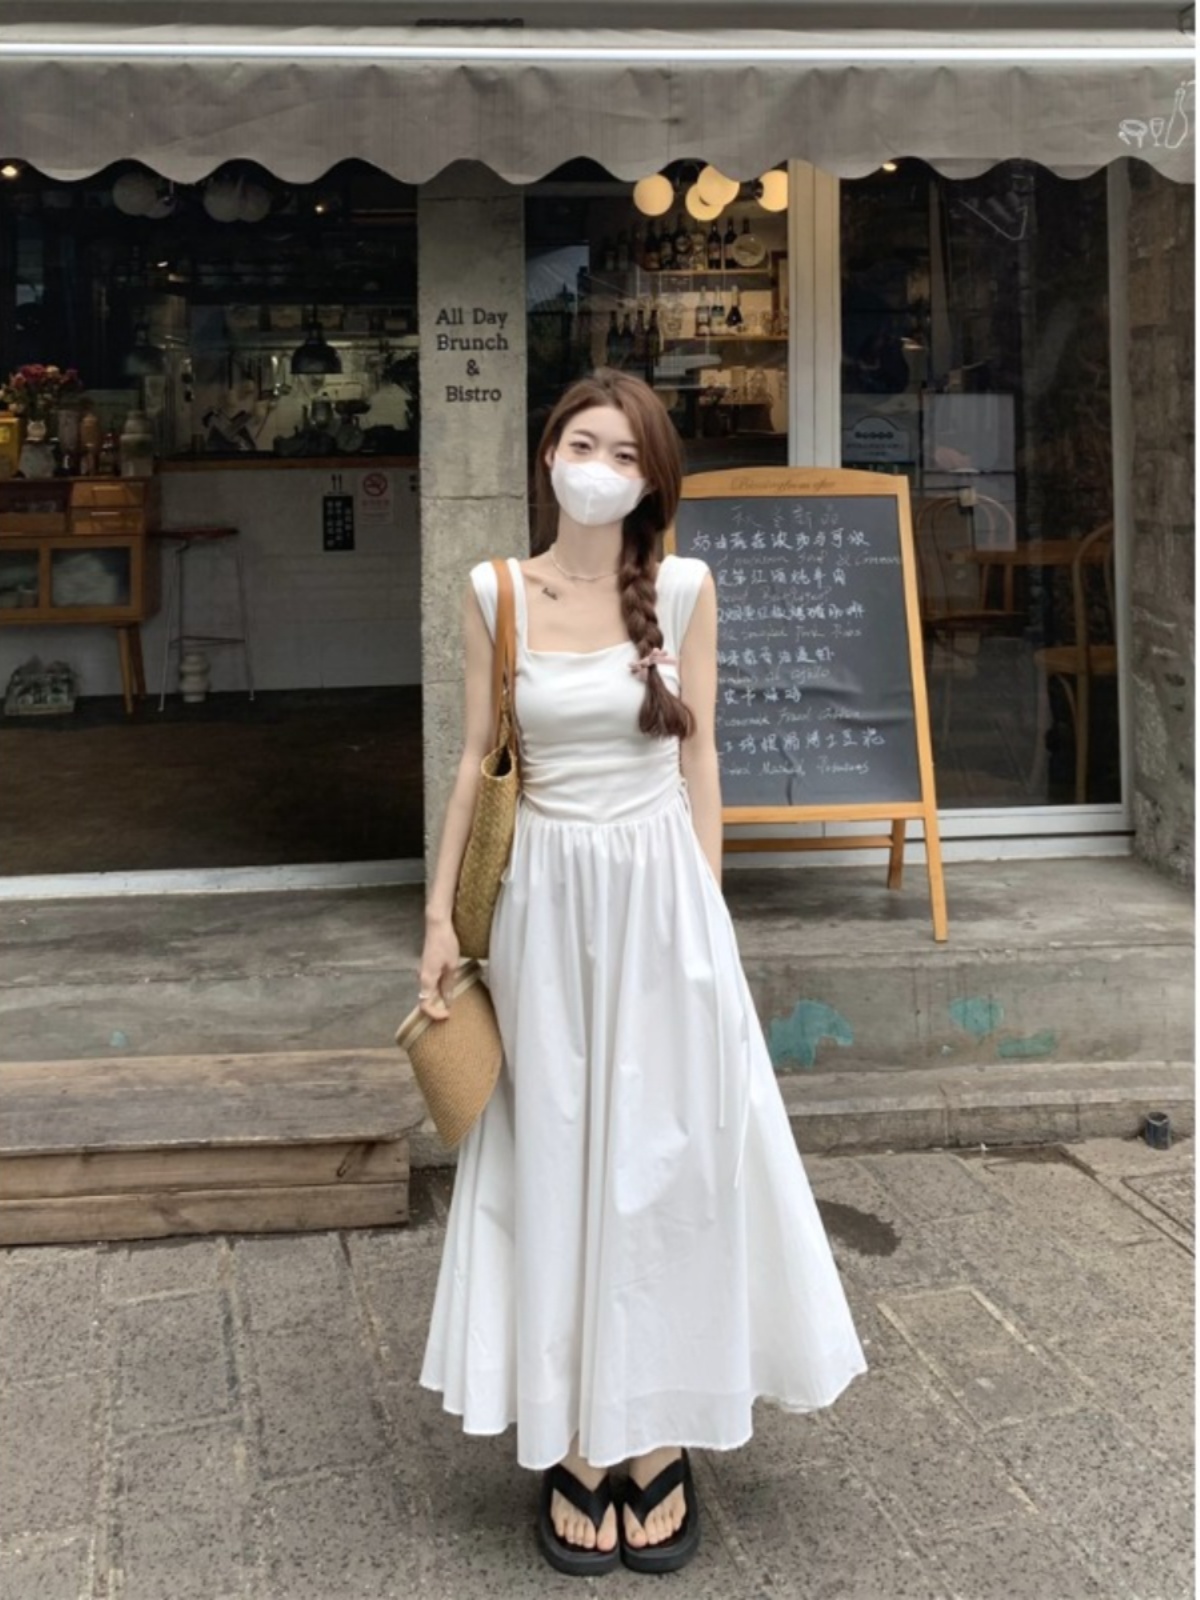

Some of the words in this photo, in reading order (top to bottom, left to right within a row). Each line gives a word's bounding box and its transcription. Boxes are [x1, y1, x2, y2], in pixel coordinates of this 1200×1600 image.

[435, 307, 463, 325] All
[472, 307, 508, 329] Day
[436, 333, 509, 351] Brunch
[466, 359, 480, 376] &
[445, 385, 502, 403] Bistro
